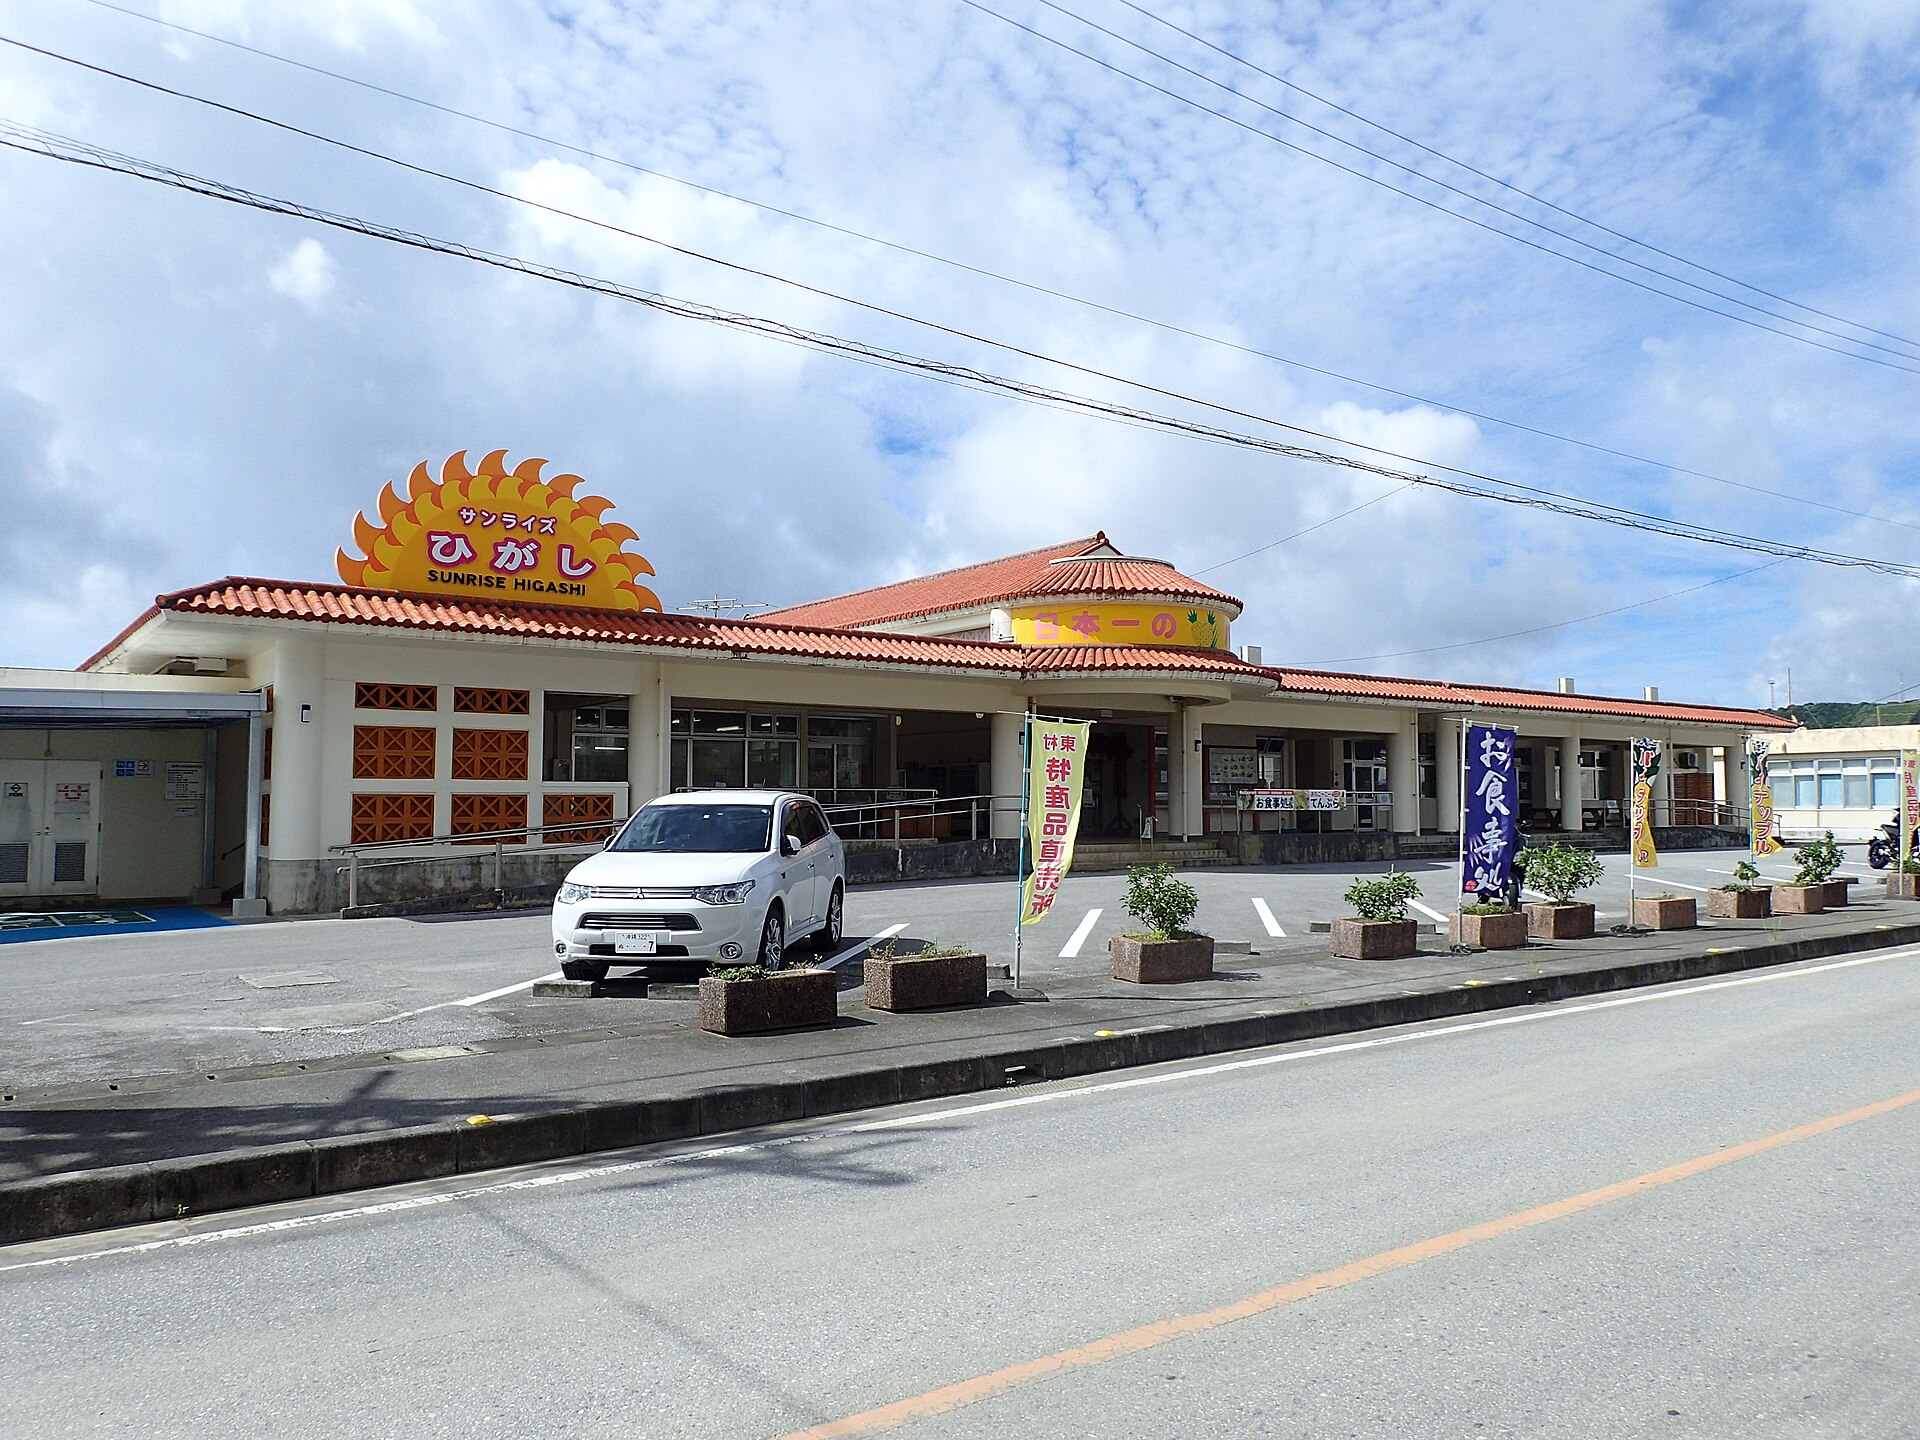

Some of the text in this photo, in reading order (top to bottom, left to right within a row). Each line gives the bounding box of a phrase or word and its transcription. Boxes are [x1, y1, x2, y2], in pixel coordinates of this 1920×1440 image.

[459, 507, 557, 536] サンライズ
[429, 533, 594, 578] ひがし
[427, 569, 586, 596] SUNRISE HIGASHI
[1035, 610, 1177, 640] 日本一の
[1256, 796, 1290, 809] お食事処
[1310, 797, 1339, 809] てんぷら
[1474, 731, 1512, 892] お食事処
